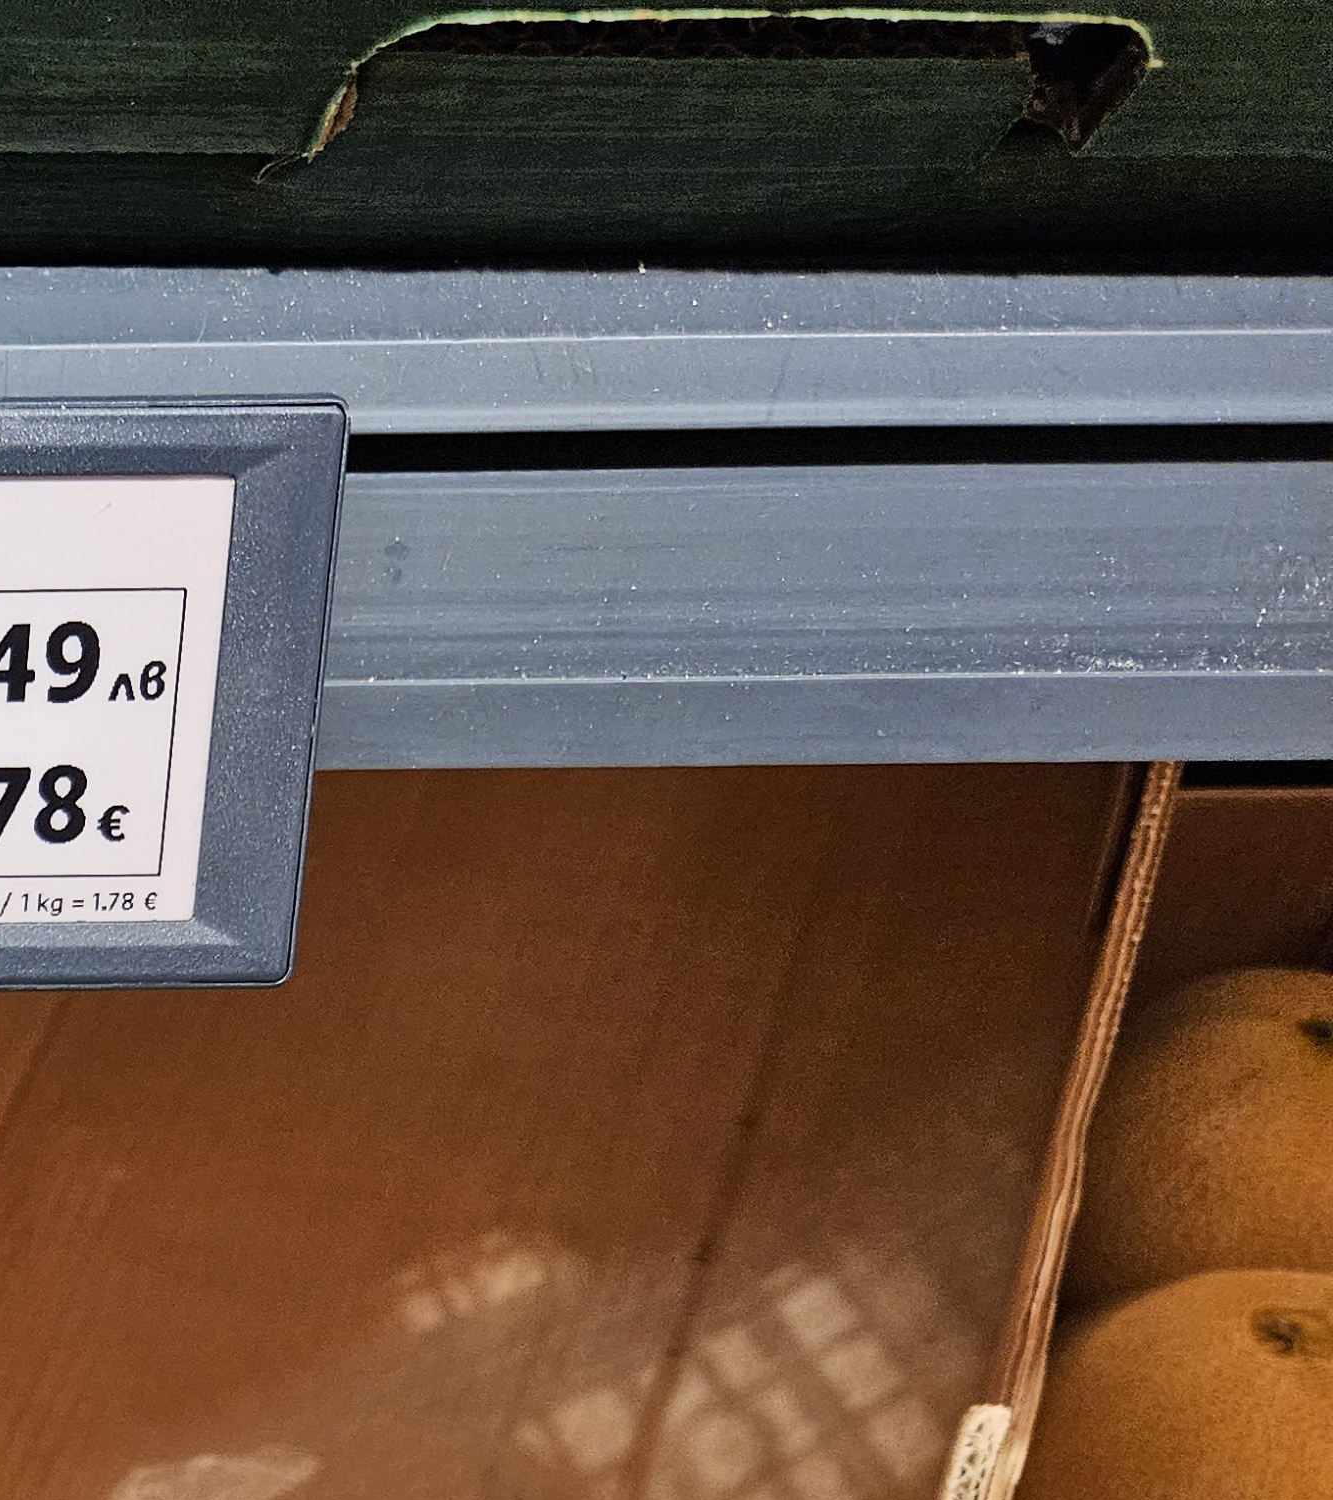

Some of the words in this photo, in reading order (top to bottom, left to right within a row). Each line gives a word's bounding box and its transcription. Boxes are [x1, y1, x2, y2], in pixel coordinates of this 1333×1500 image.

[21, 893, 29, 912] 1
[37, 893, 64, 917] kg
[92, 892, 135, 912] 1.78
[144, 891, 158, 911] €
